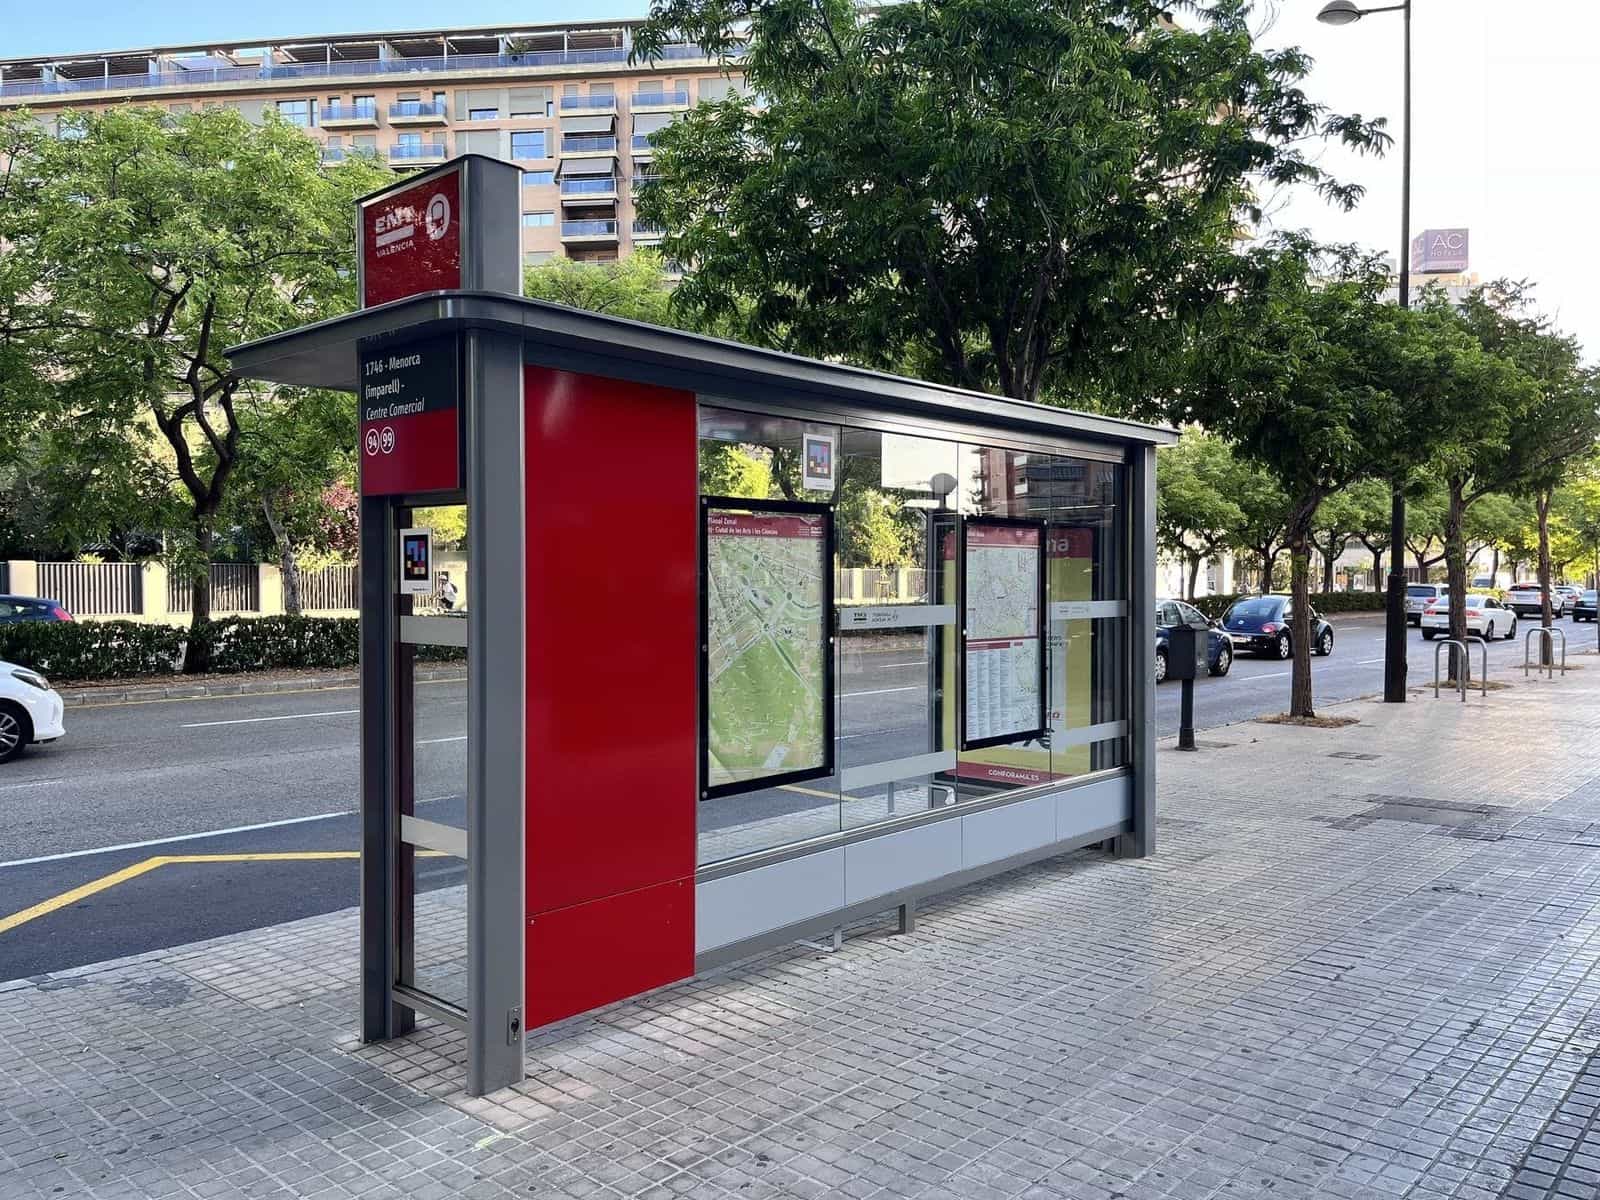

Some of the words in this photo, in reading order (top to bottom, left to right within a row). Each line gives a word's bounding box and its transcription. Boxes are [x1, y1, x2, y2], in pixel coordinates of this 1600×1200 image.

[1431, 233, 1464, 249] AC
[365, 360, 383, 376] 1746
[389, 354, 421, 371] Menorca
[365, 378, 400, 400] (imparell)
[366, 406, 388, 421] Centre
[389, 397, 425, 417] Comercial
[367, 435, 378, 449] 94
[382, 432, 393, 447] 99
